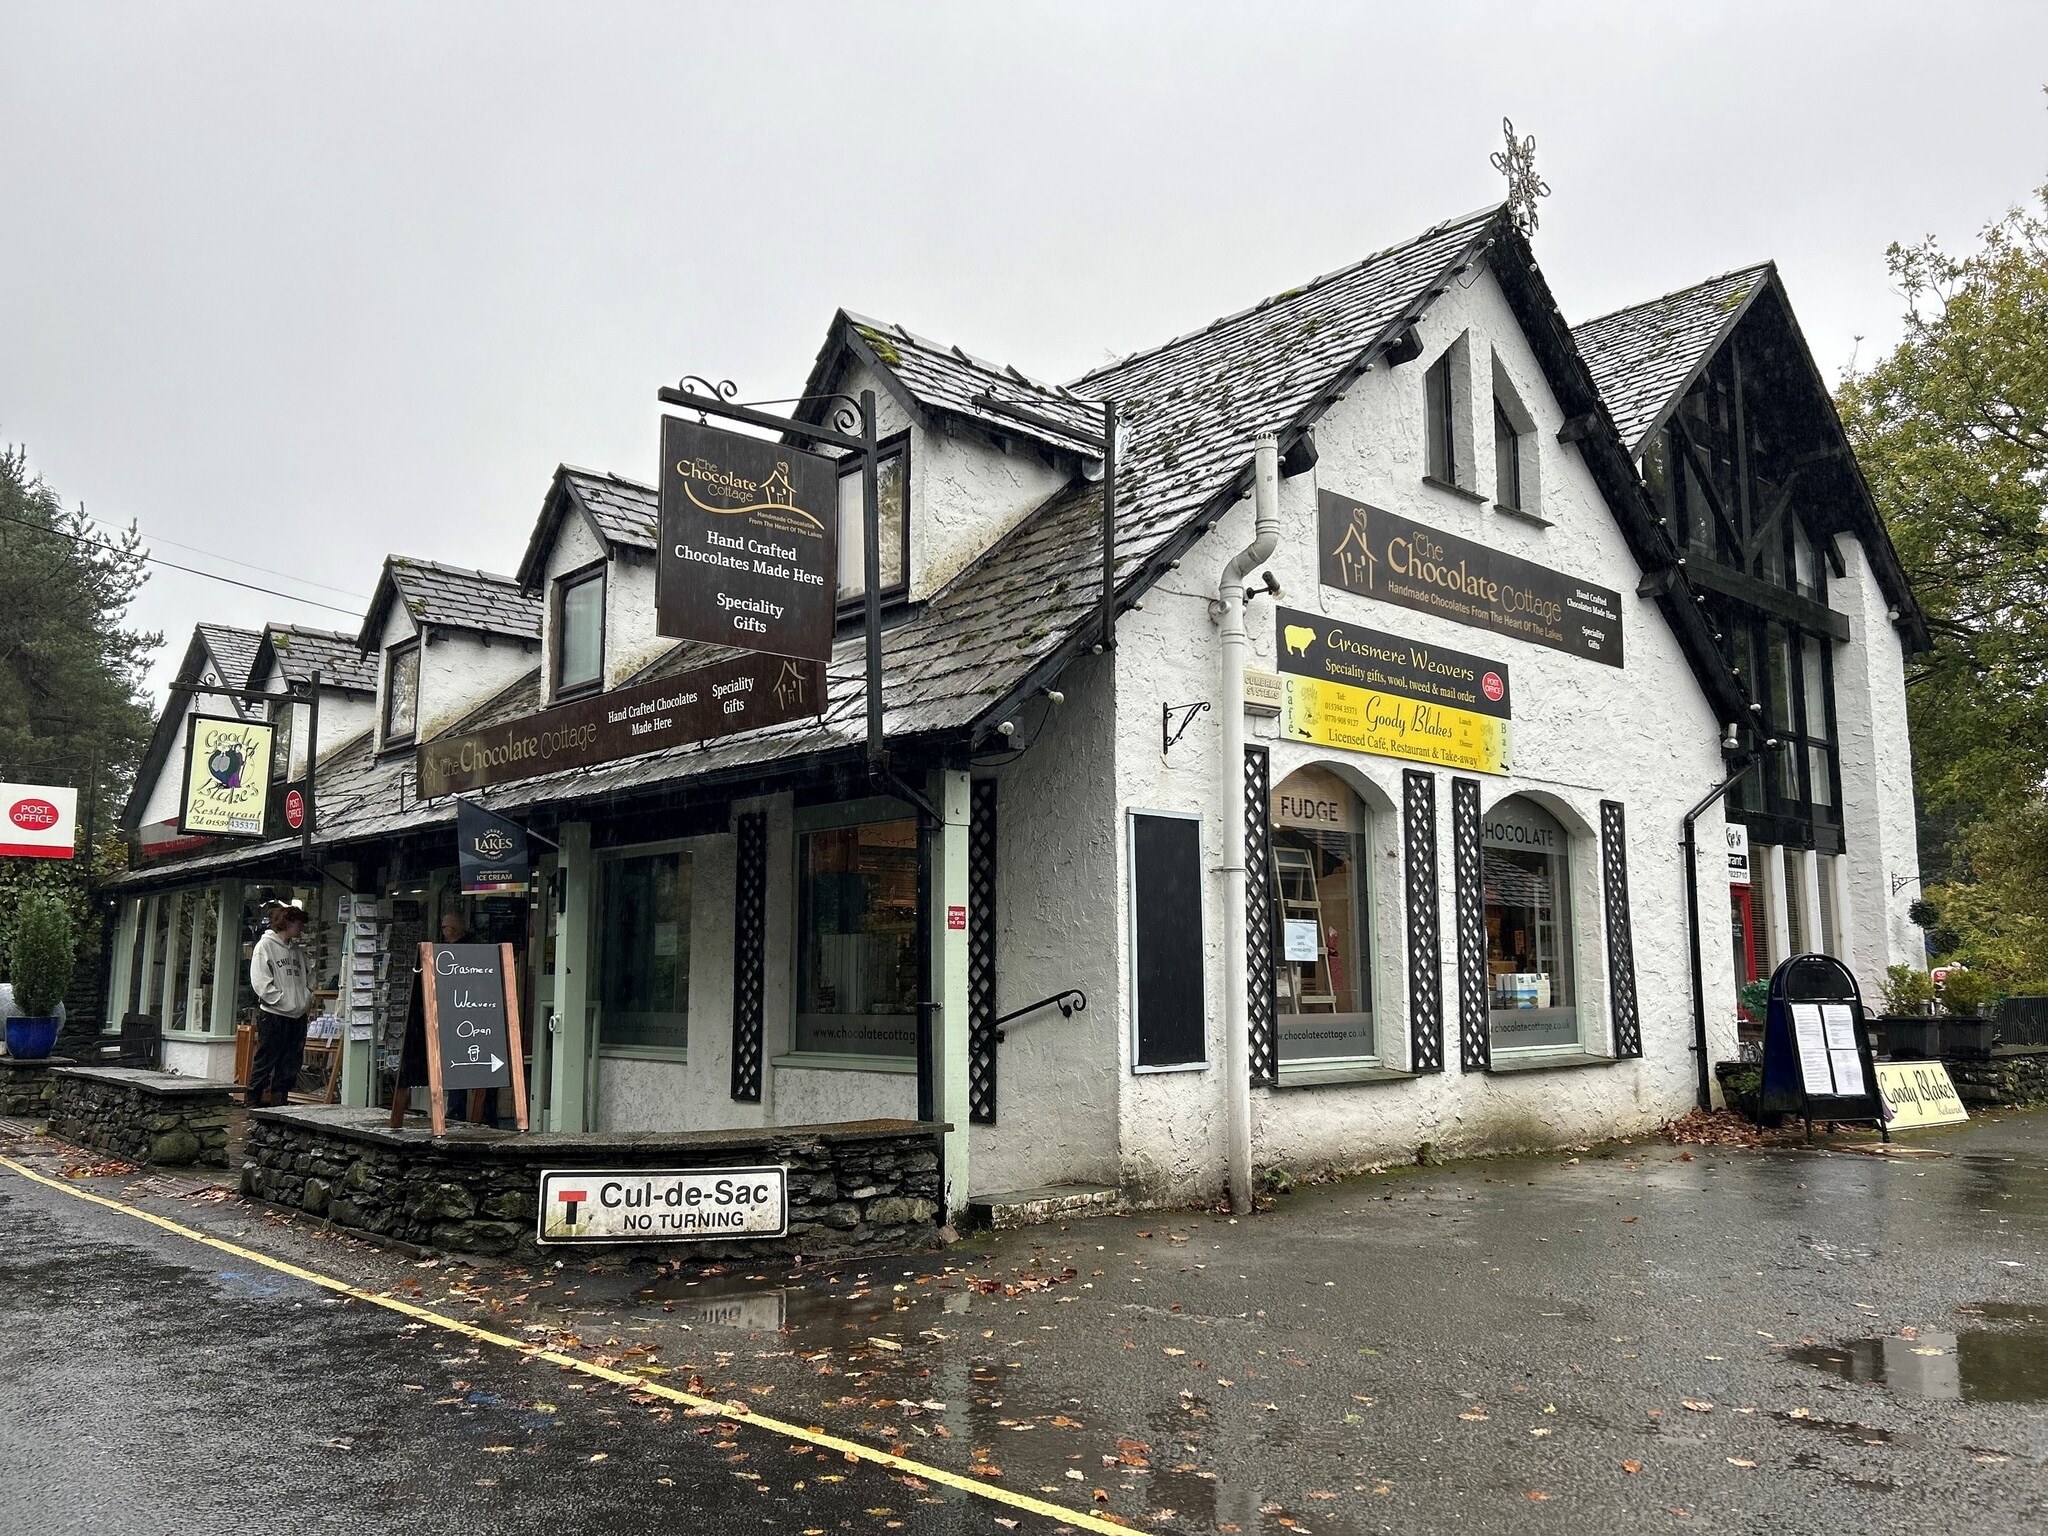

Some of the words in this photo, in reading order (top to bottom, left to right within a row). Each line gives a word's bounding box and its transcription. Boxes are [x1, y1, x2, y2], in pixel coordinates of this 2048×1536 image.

[676, 459, 757, 492] Chocolate
[696, 458, 718, 472] The
[707, 483, 753, 503] Cottage
[748, 517, 762, 526] From
[763, 520, 773, 529] The
[774, 522, 789, 532] Heart
[790, 525, 797, 533] Of
[798, 527, 807, 536] The
[808, 529, 823, 539] Lakes
[757, 511, 786, 524] Handmade
[787, 517, 815, 529] Chocolates
[706, 530, 744, 550] Hand
[748, 540, 797, 561] Crafted
[1413, 531, 1444, 562] The
[674, 545, 749, 571] Chocolates
[752, 560, 790, 580] Made
[793, 568, 824, 585] Here
[1387, 537, 1499, 603] Chocolate
[1501, 585, 1562, 625] Cottage
[716, 592, 784, 618] Speciality
[1388, 580, 1430, 604] Handmade
[1430, 593, 1470, 616] Chocolates
[1471, 604, 1489, 621] From
[1489, 609, 1503, 624] The
[1504, 614, 1523, 631] Heart
[1523, 619, 1532, 632] Of
[1532, 622, 1544, 636] The
[1544, 624, 1563, 642] Lakes
[733, 616, 767, 633] Gifts
[1327, 628, 1407, 666] Grasmere
[1409, 647, 1475, 681] Weavers
[712, 676, 754, 699] Speciality
[1244, 674, 1282, 690] CUMBRIAN
[1325, 658, 1366, 681] Speciality
[1366, 667, 1387, 685] gifts,
[1388, 674, 1407, 690] wool,
[1409, 679, 1431, 694] tweed
[1431, 684, 1438, 694] &
[1439, 686, 1456, 699] mail
[1457, 690, 1476, 703] order
[1485, 685, 1501, 695] OFFICE
[1487, 677, 1499, 687] POST
[1246, 687, 1279, 699] SYSTEMS
[608, 710, 627, 724] Hand
[628, 700, 655, 718] Crafted
[657, 691, 698, 711] Chocolates
[723, 699, 745, 715] Gifts
[1365, 695, 1407, 737] Goody
[1411, 704, 1453, 738] Blakes
[631, 721, 652, 736] Made
[653, 717, 672, 731] Here
[204, 727, 260, 756] Goody
[439, 755, 460, 778] The
[460, 730, 538, 773] Chocolate
[541, 723, 597, 759] Cottage
[1328, 728, 1366, 747] Licensed
[1367, 735, 1389, 751] Café,
[1390, 739, 1430, 757] Restaurant
[1431, 748, 1438, 758] &
[1440, 748, 1478, 768] Take-away
[198, 778, 259, 804] Blake's
[21, 804, 50, 814] POST
[189, 799, 262, 818] Restaurant
[289, 798, 300, 808] POST
[1280, 796, 1339, 823] FUDGE
[13, 813, 53, 824] OFFICE
[288, 810, 302, 819] OFFICE
[1482, 821, 1554, 847] HOCOLATE
[488, 873, 513, 881] CREAM
[435, 950, 494, 976] Grasmere
[454, 989, 497, 1009] Weavers
[456, 1020, 492, 1038] Open
[813, 1025, 918, 1045] www.chocolatecottag
[1491, 1020, 1570, 1033] .chocolatecottage.co.uk
[1880, 1071, 1923, 1115] Goody
[599, 1180, 769, 1209] Cul-de-Sac
[623, 1214, 653, 1230] NO
[659, 1211, 744, 1229] TURNING
